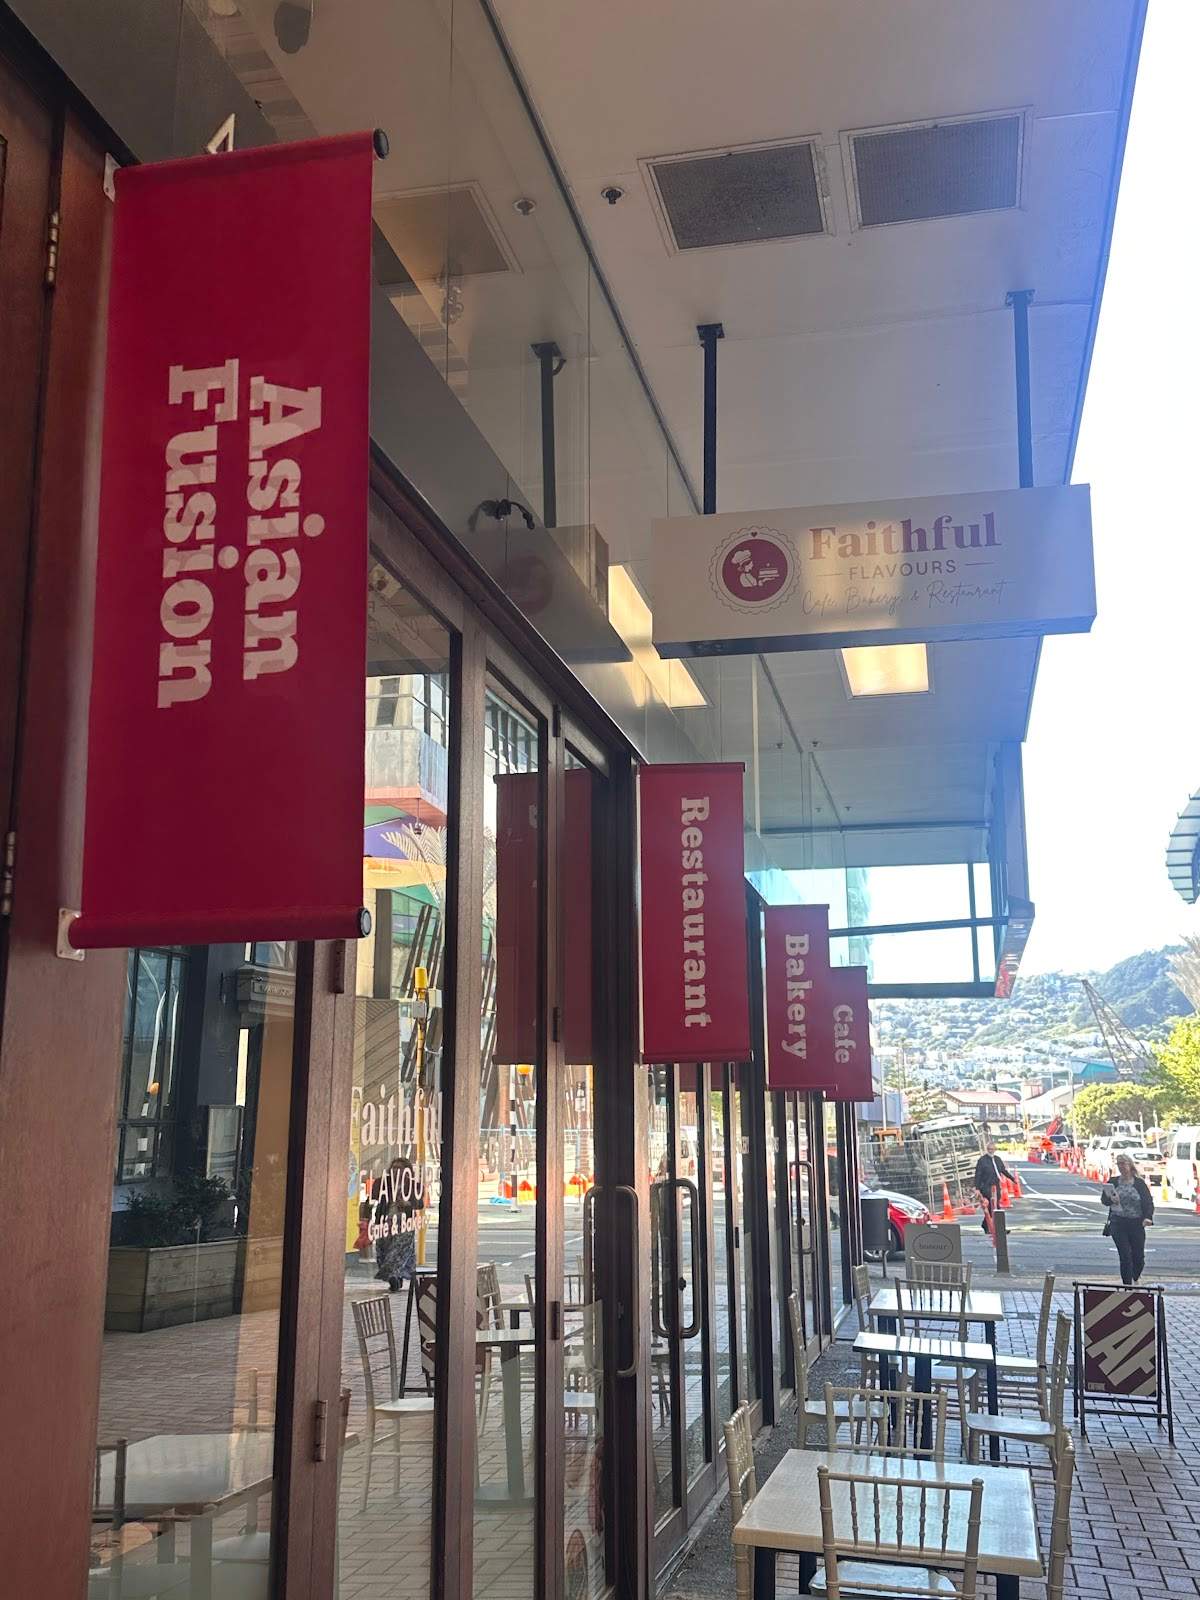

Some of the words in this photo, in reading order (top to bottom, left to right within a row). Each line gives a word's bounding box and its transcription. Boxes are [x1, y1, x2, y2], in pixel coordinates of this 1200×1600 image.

[157, 358, 239, 709] Fusion
[242, 376, 325, 681] Asian
[808, 512, 1003, 561] Faithful
[848, 559, 958, 581] FLAVOURS
[680, 796, 712, 1029] Restaurant
[781, 933, 814, 1060] Bakery
[350, 1083, 444, 1146] Faithful
[391, 1212, 399, 1238] &
